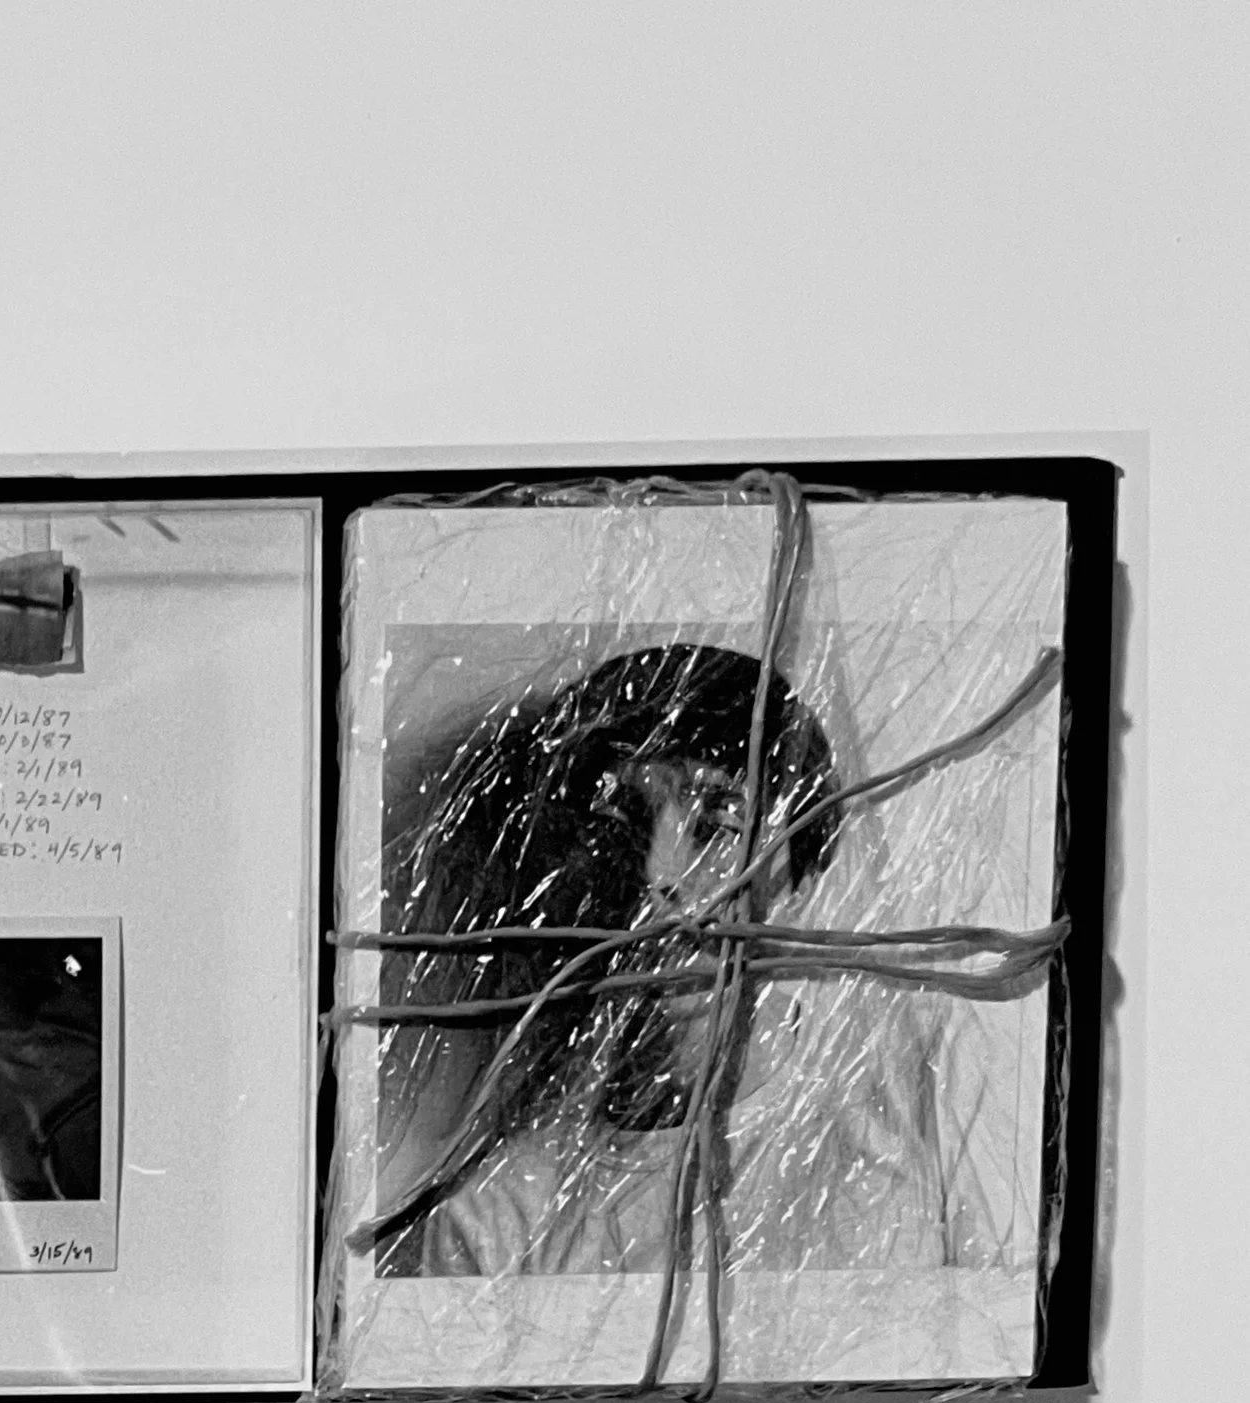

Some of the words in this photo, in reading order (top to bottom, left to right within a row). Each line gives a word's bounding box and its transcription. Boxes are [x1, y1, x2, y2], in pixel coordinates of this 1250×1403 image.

[17, 757, 82, 782] 2/1/89
[15, 788, 102, 811] 2/22/89
[47, 836, 122, 863] 4/5/89
[29, 1240, 93, 1265] 3/15/89
